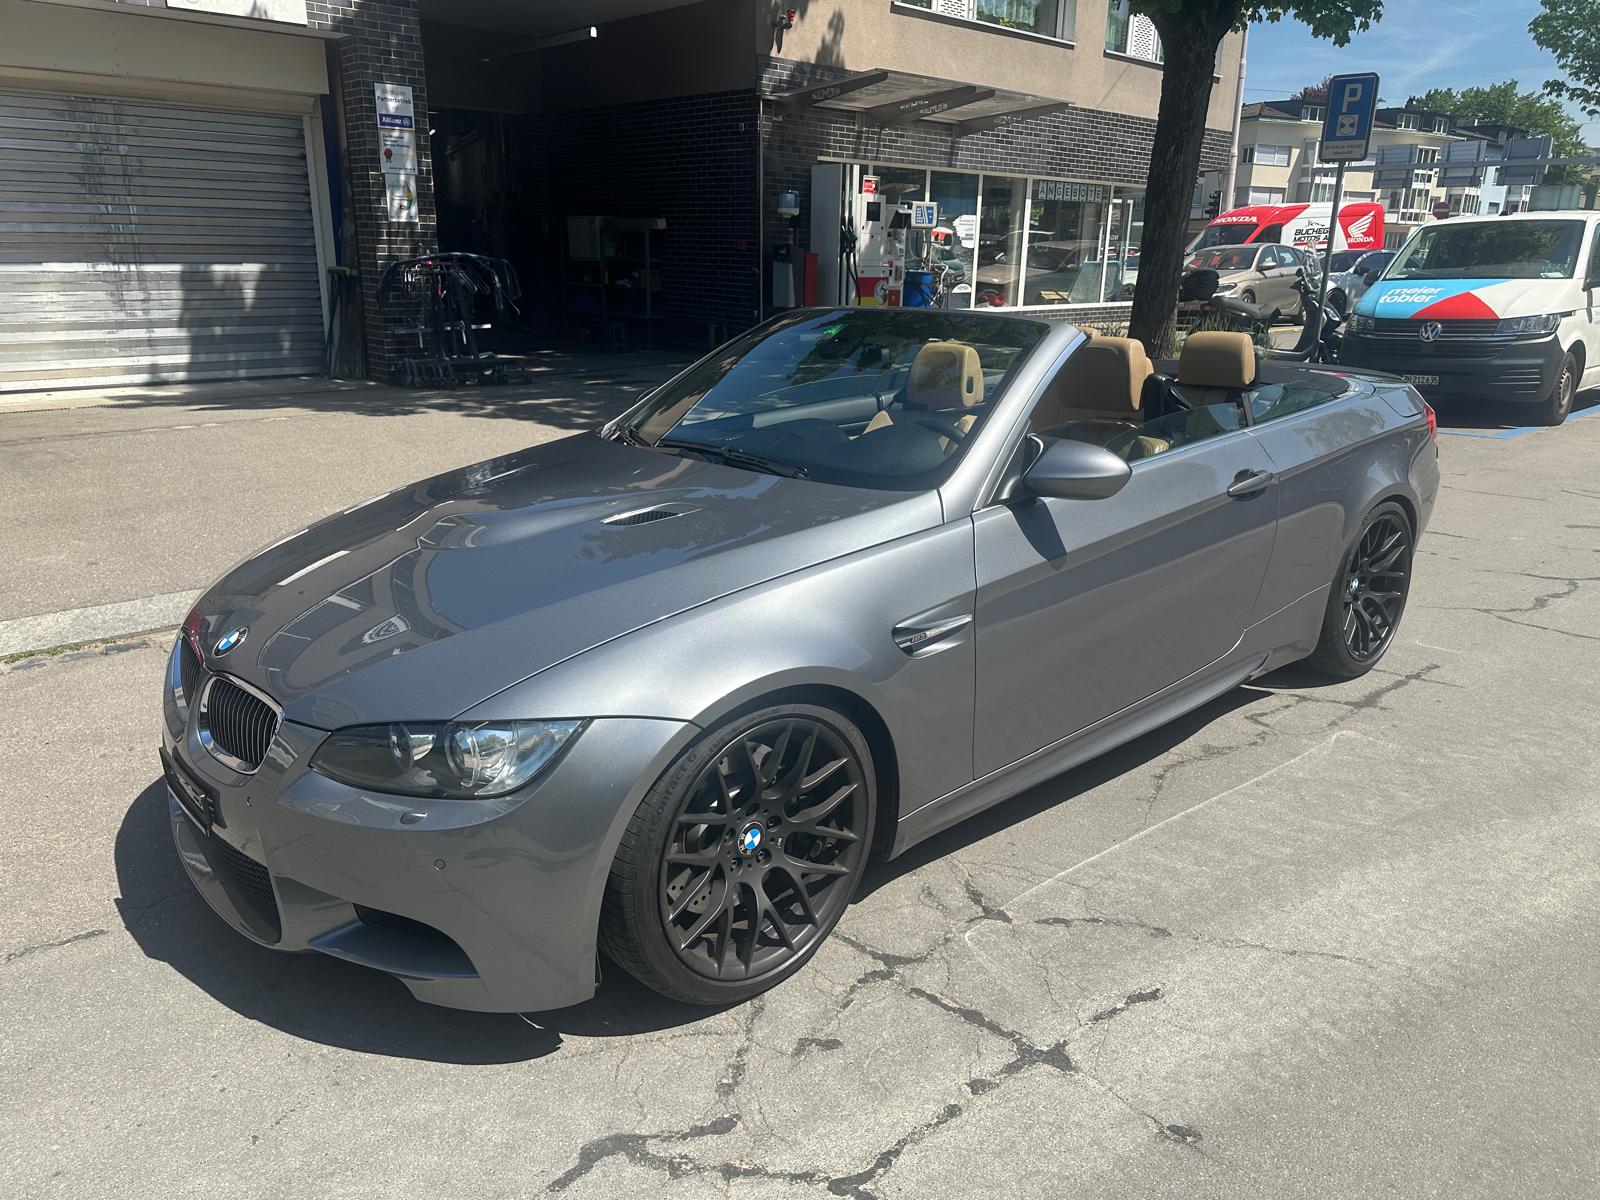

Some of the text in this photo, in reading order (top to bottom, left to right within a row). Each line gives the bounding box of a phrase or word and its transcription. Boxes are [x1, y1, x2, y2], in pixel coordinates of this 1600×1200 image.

[1342, 83, 1362, 113] P
[1040, 186, 1101, 197] ANGEBOTE
[1212, 216, 1258, 225] HONDA
[1294, 227, 1330, 236] BUCHEG
[1347, 236, 1374, 244] HONDA
[1387, 286, 1446, 295] meier
[1379, 293, 1437, 303] tobler
